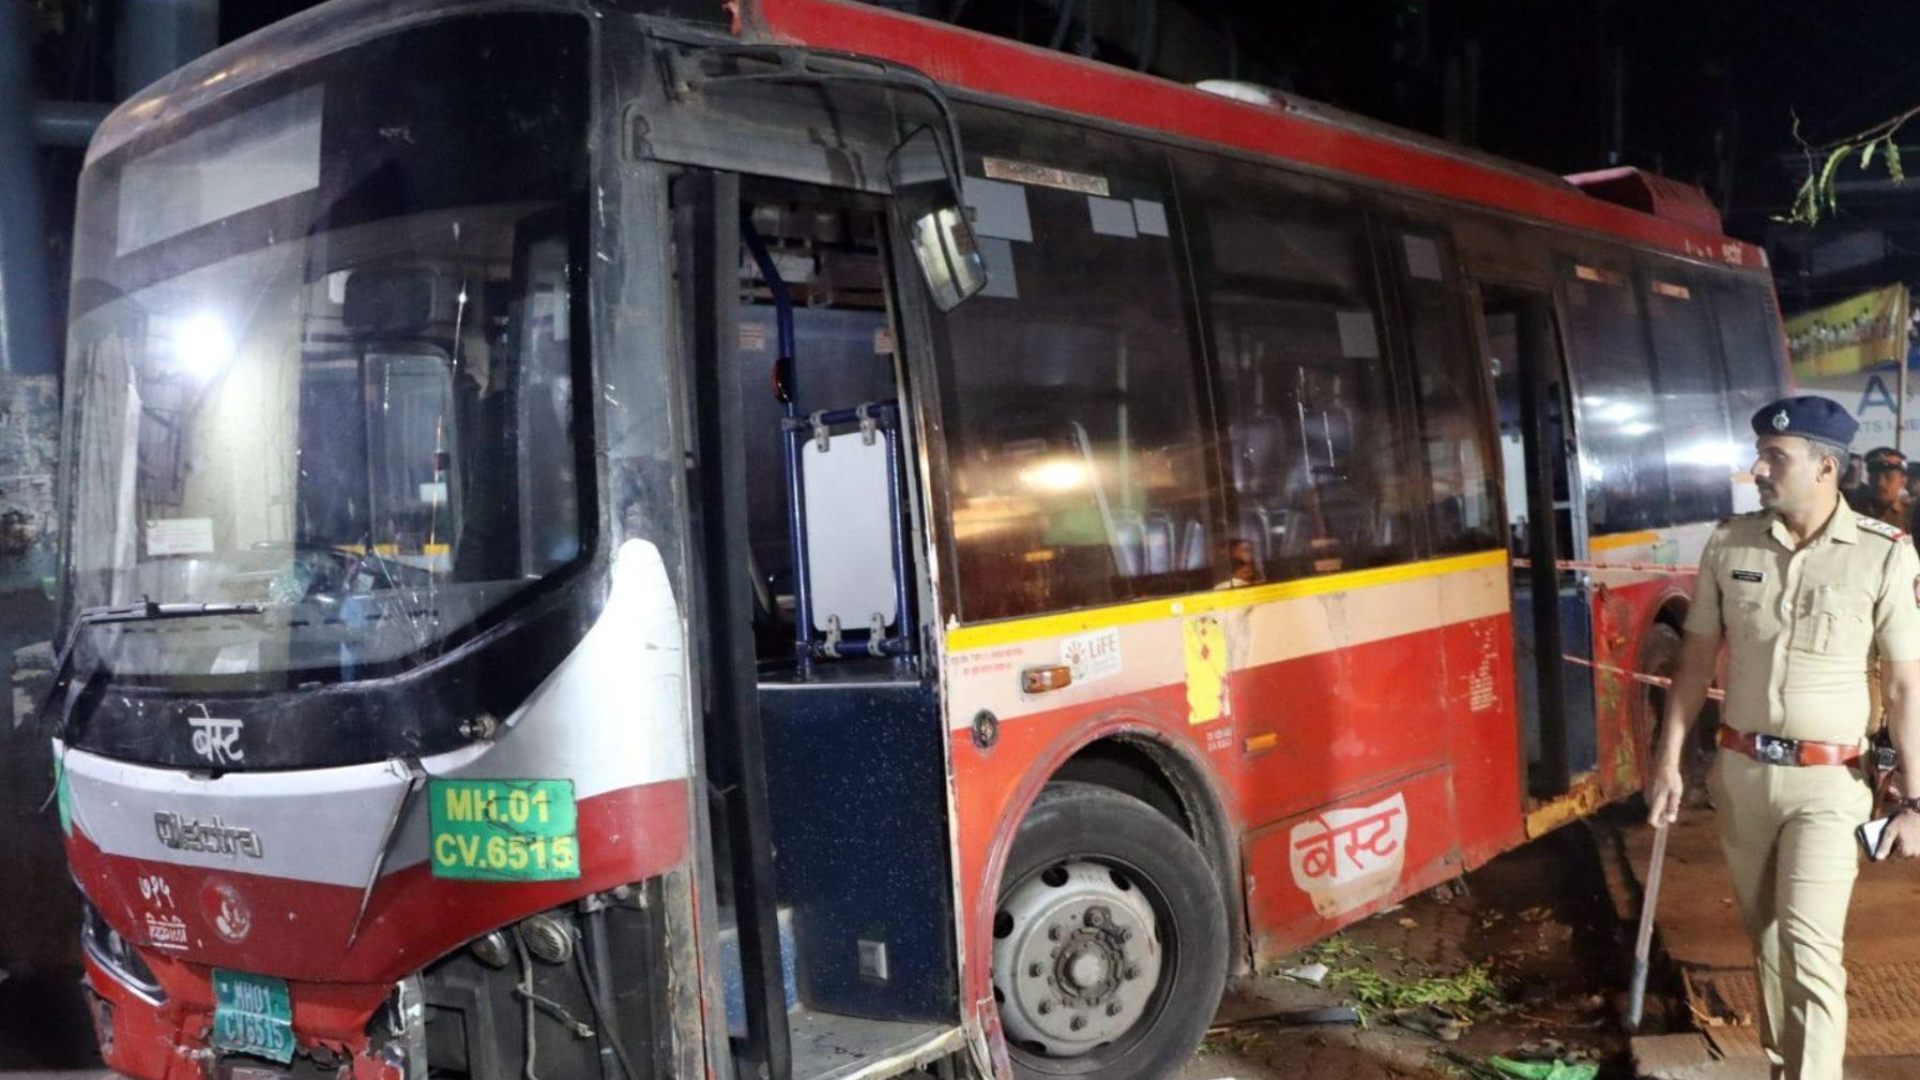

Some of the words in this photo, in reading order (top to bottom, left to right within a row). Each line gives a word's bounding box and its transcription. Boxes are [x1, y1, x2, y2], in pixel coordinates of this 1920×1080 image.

[187, 703, 245, 766] बेस्ट
[445, 788, 549, 824] MH.01
[434, 832, 574, 870] CV.6515
[1294, 806, 1401, 878] बेस्ट
[234, 980, 272, 1016] MH01
